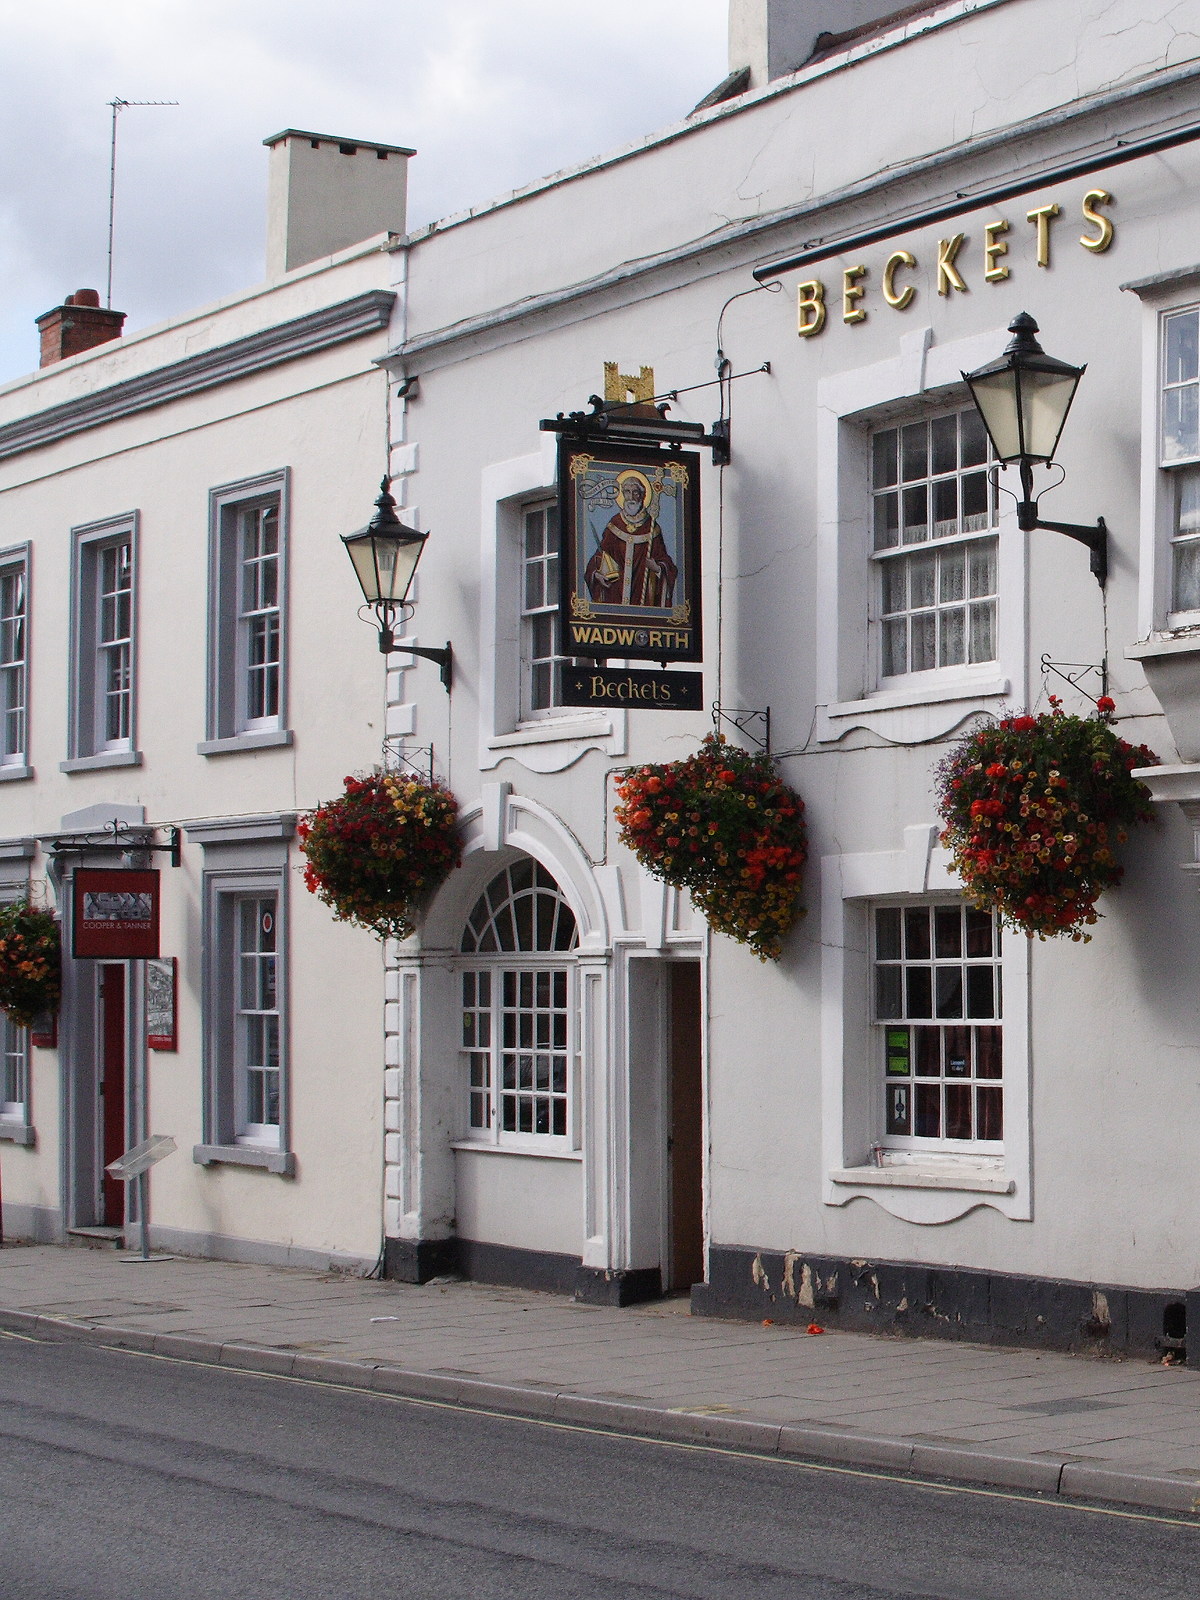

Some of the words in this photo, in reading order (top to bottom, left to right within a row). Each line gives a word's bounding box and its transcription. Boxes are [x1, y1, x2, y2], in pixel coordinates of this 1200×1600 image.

[797, 188, 1113, 338] BECKETS
[571, 626, 689, 649] WADWORTH
[589, 675, 671, 700] Beckets
[83, 921, 115, 930] COOPER
[124, 922, 152, 930] TANNER
